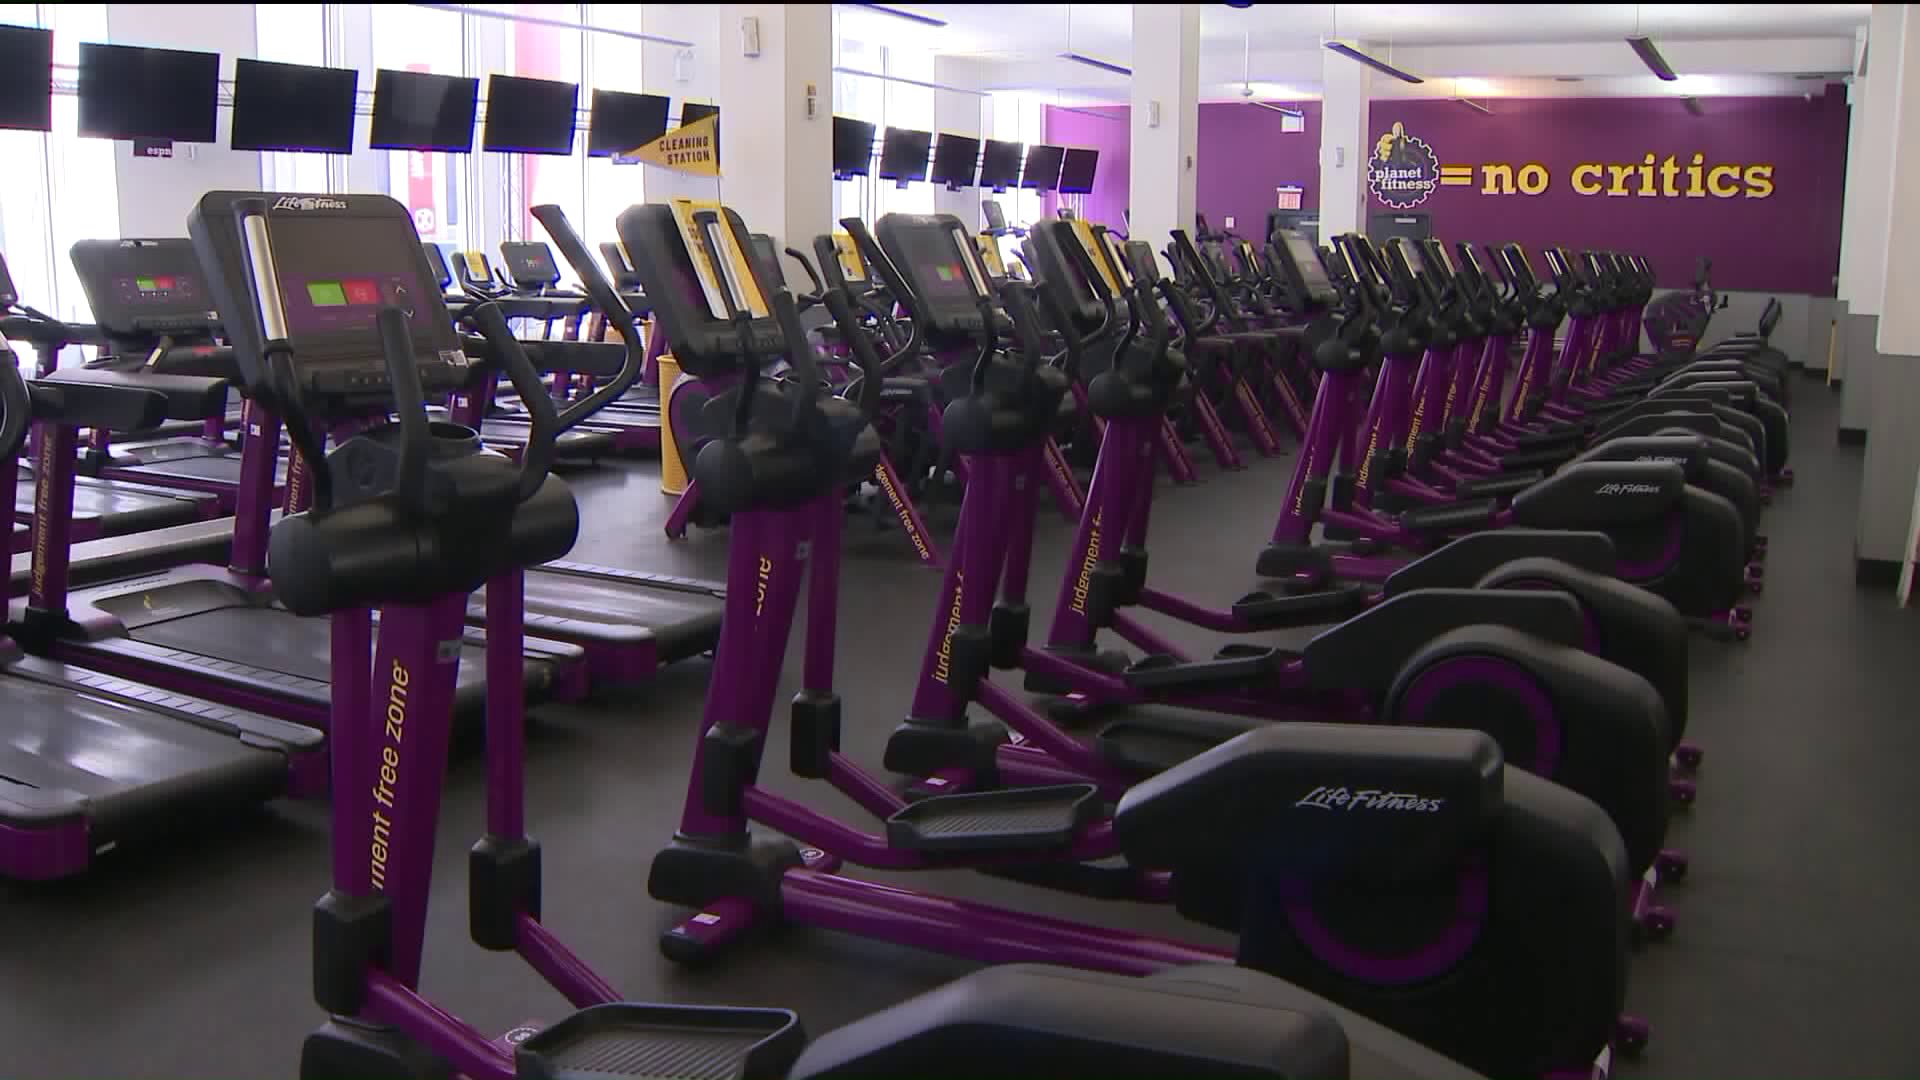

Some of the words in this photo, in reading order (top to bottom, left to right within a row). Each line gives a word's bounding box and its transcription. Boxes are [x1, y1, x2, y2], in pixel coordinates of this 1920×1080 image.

[659, 136, 708, 152] CLEANING
[668, 150, 710, 165] STATION
[1375, 166, 1422, 182] planet
[1380, 178, 1431, 190] fitness
[1481, 162, 1549, 195] no
[1571, 152, 1774, 199] critics
[272, 196, 300, 211] Life
[911, 531, 929, 560] zone
[1068, 529, 1100, 616] judgement
[373, 746, 399, 809] free
[386, 664, 409, 743] zone
[1296, 786, 1350, 809] Life
[1347, 790, 1442, 812] Fitness
